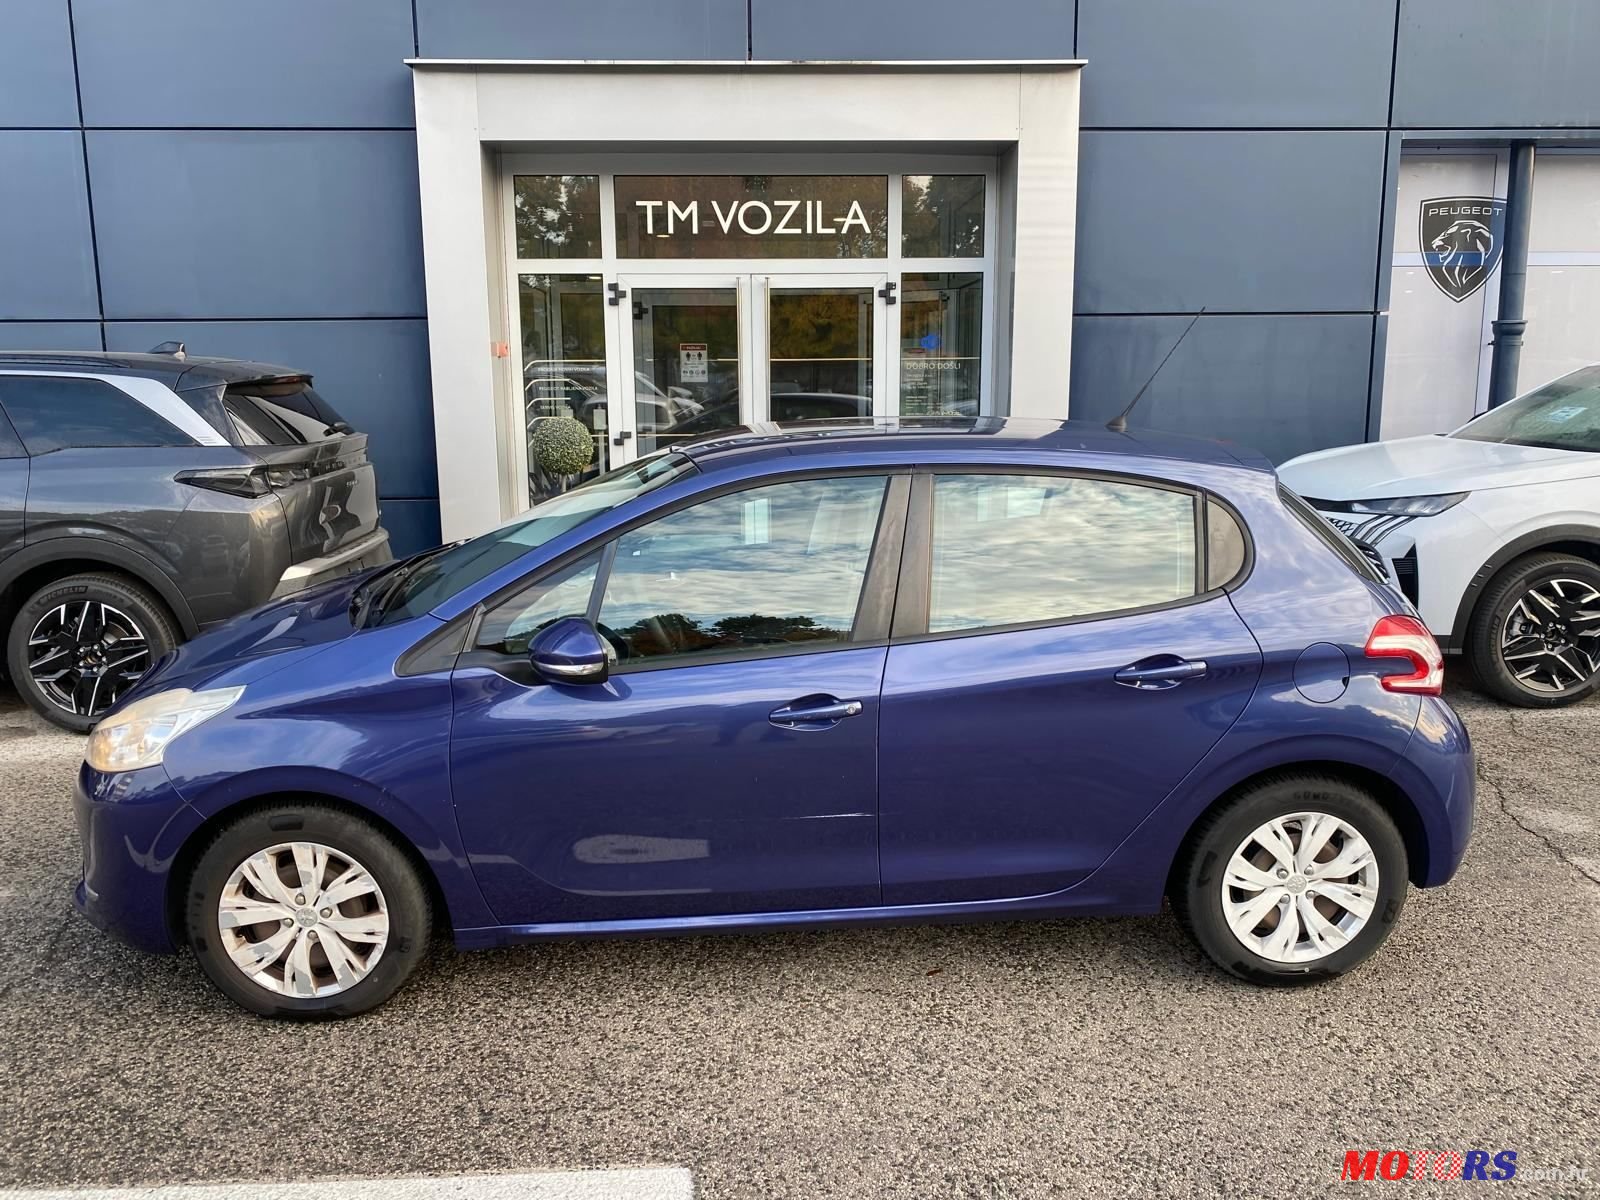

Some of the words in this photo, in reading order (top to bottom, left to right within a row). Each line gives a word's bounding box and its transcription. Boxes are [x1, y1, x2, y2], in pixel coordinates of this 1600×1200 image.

[636, 200, 699, 235] TM
[711, 200, 871, 235] VOZILA
[1429, 206, 1503, 216] PEUGEOT
[39, 586, 88, 605] MICHELIN
